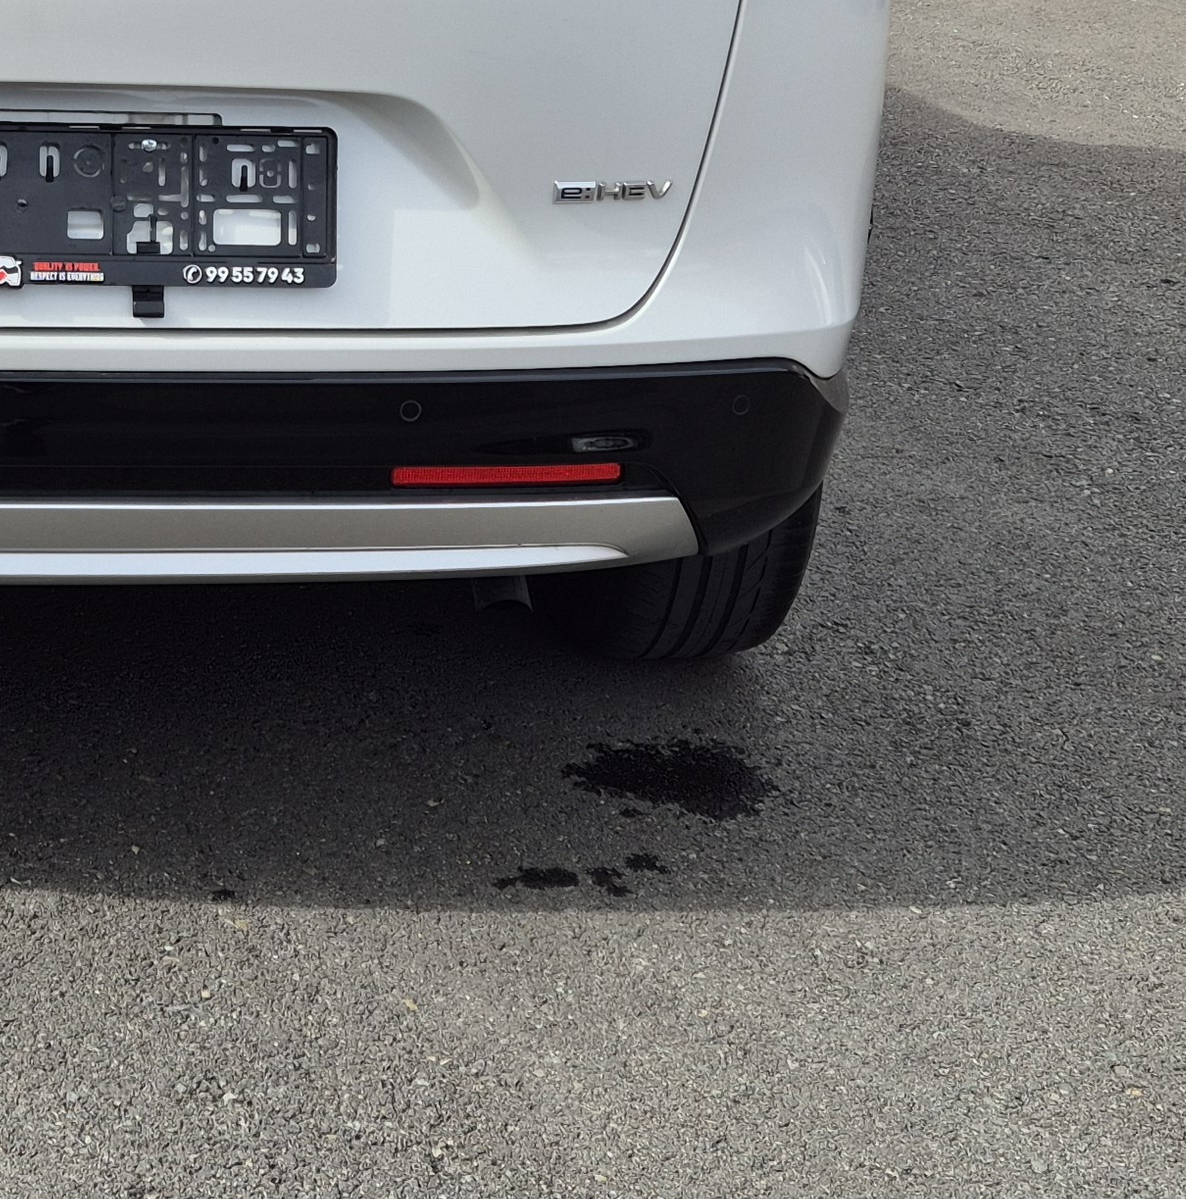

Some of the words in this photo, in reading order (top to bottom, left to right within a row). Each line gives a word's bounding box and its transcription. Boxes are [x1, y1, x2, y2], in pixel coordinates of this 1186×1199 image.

[58, 272, 66, 281] IS
[205, 266, 229, 283] 99
[231, 266, 254, 283] 55
[256, 267, 279, 283] 79
[281, 267, 305, 284] 43
